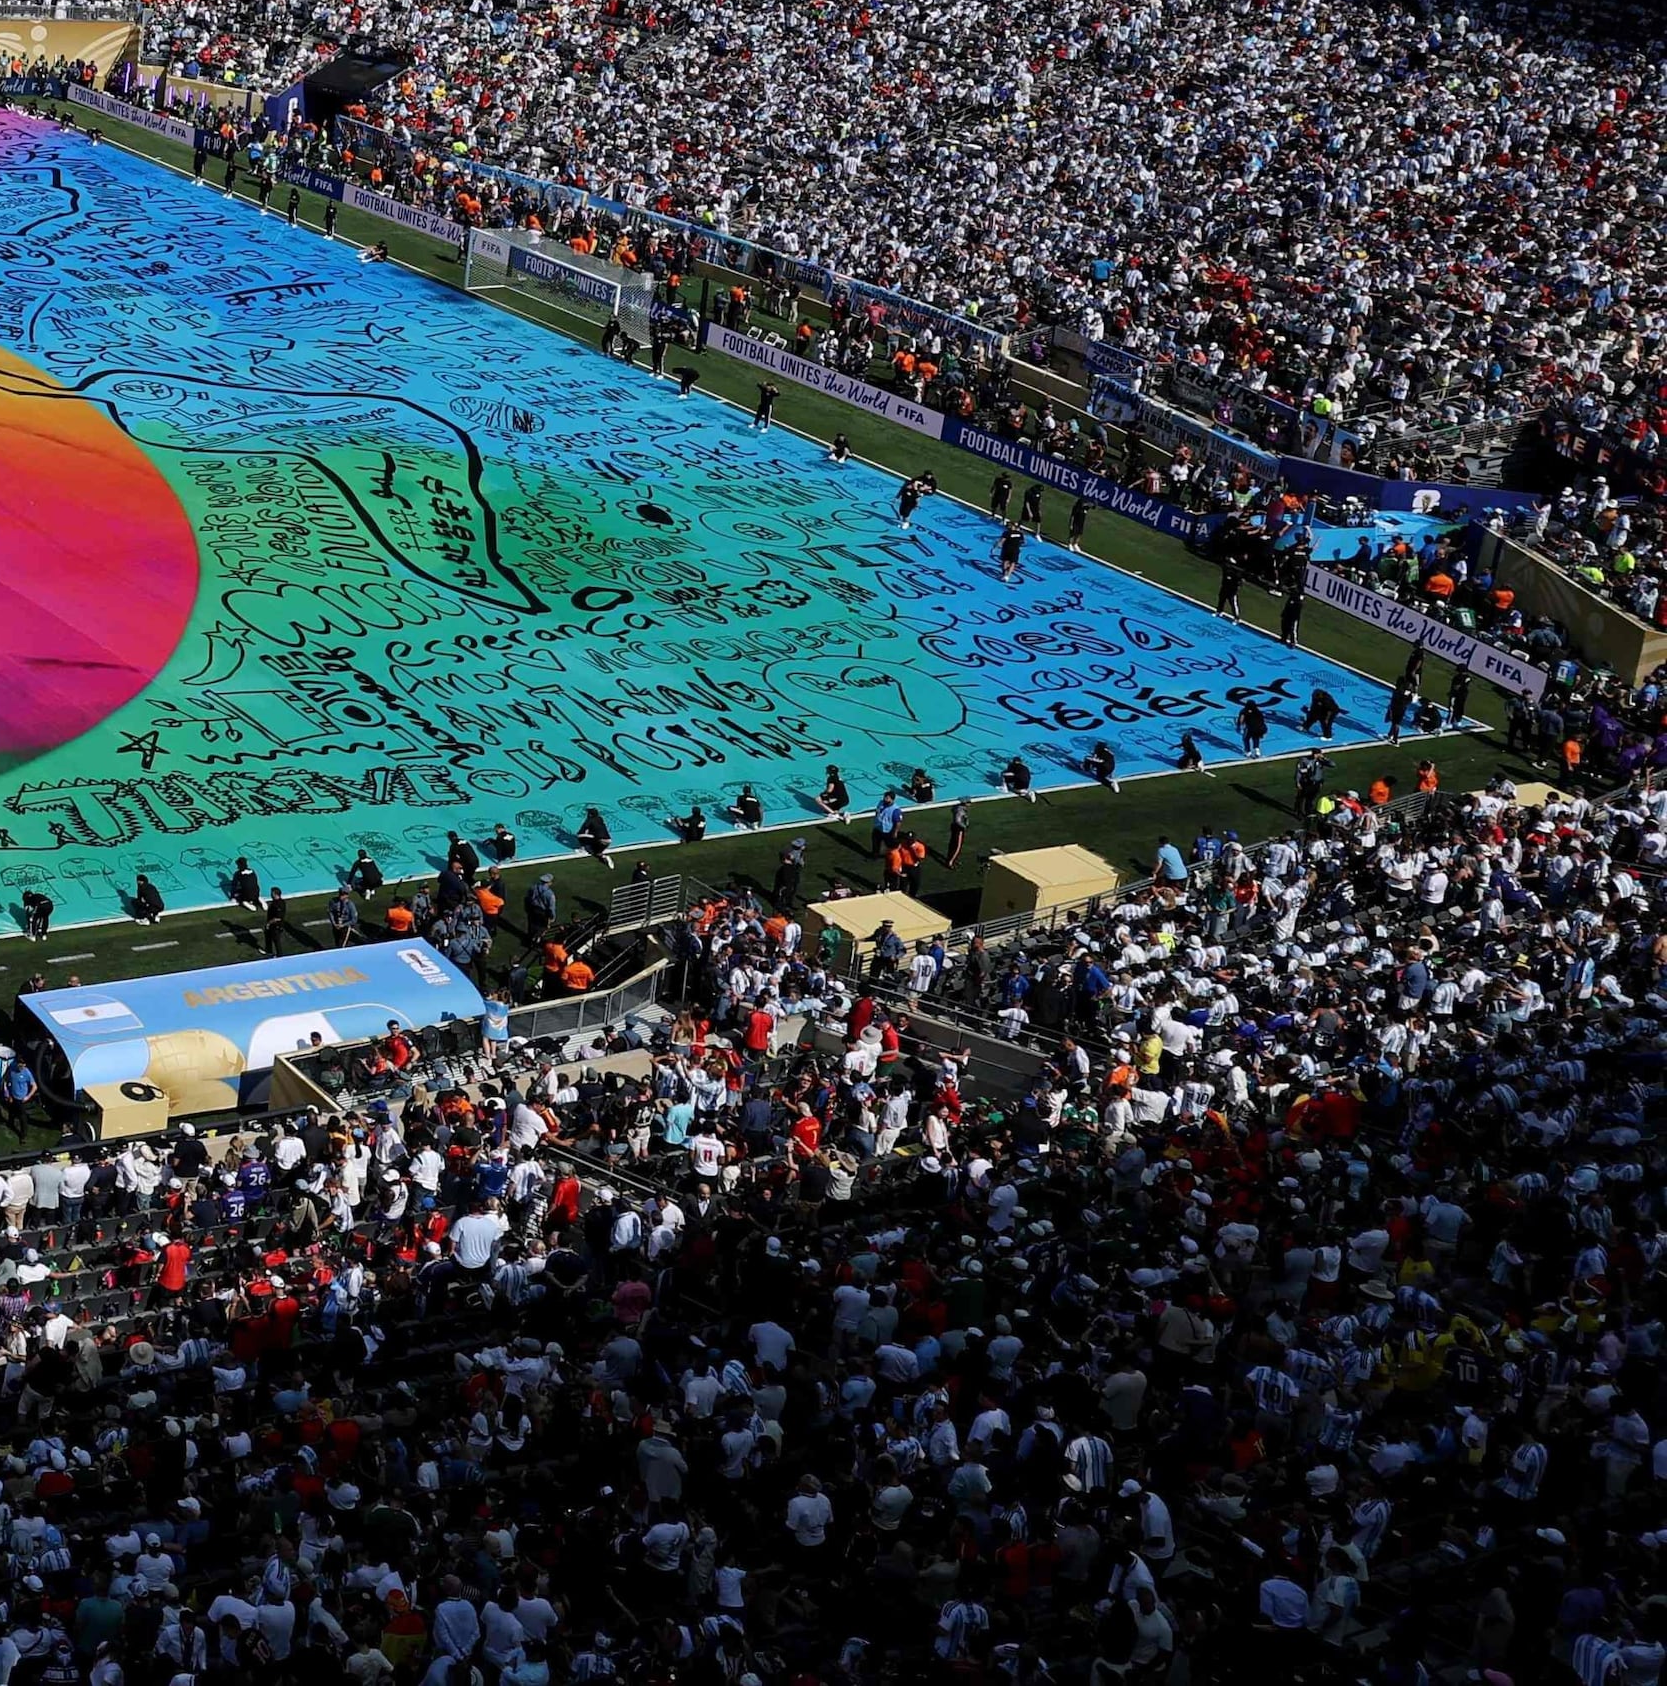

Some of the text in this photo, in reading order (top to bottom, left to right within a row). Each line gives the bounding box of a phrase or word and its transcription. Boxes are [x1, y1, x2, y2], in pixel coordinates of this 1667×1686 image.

[314, 177, 333, 194] FIFA
[722, 332, 926, 427] FOOTBALL UNITES the World FIFA
[959, 427, 1165, 528] FOOTBALL UNITES the World
[1327, 577, 1382, 620] UNITES
[1385, 603, 1419, 635] the
[1418, 619, 1475, 670] World
[1484, 655, 1527, 686] FIFA
[183, 967, 370, 1008] ARGENTINA
[248, 1172, 266, 1187] 26
[229, 1203, 245, 1218] 26
